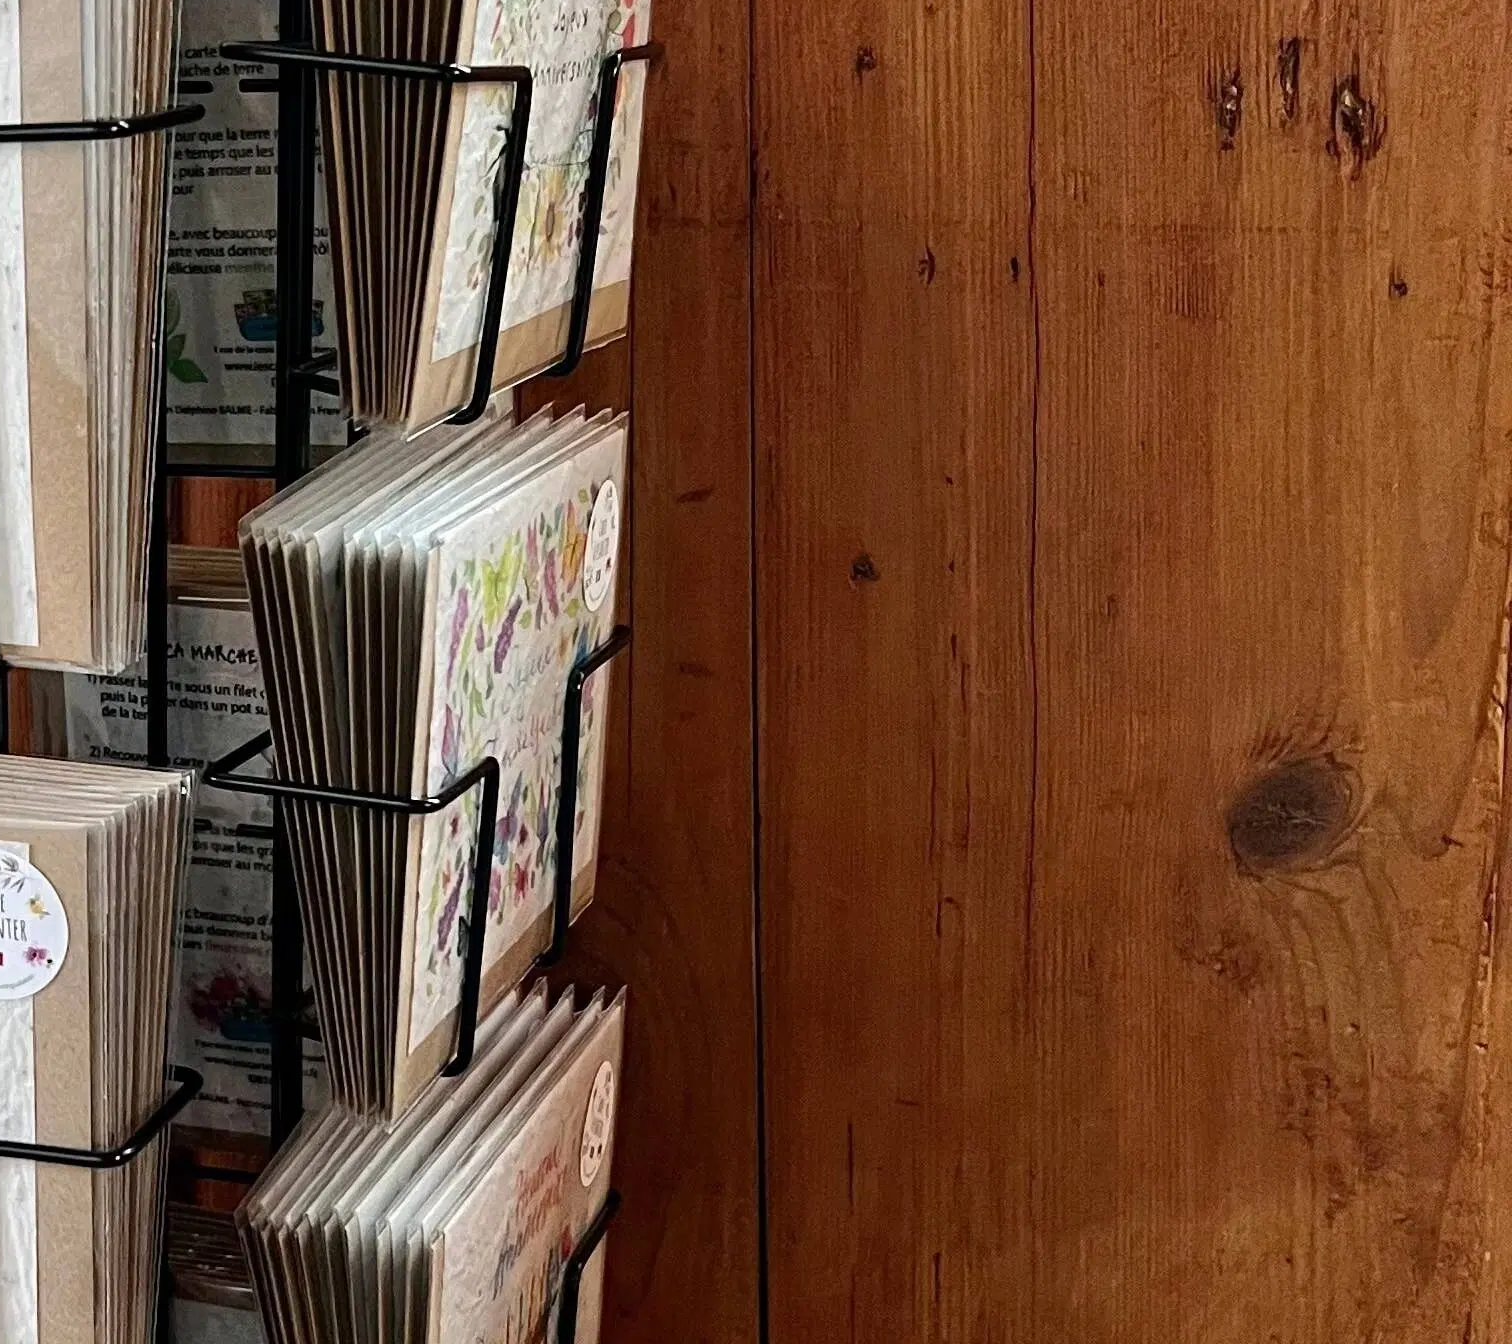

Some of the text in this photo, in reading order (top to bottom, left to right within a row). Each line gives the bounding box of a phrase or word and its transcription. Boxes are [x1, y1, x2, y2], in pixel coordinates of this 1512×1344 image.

[213, 61, 229, 76] de
[199, 131, 223, 144] que
[226, 127, 238, 141] la
[240, 128, 270, 141] terre
[185, 147, 226, 162] temps
[228, 147, 253, 161] que
[256, 144, 274, 158] les
[179, 164, 272, 181] puis arroser au
[182, 229, 210, 240] avec
[195, 246, 225, 258] vous
[190, 644, 258, 665] MARCHE
[185, 683, 212, 694] sous
[214, 684, 231, 696] un
[234, 683, 258, 699] filet
[100, 690, 126, 704] puis
[127, 690, 138, 705] la
[180, 697, 209, 712] dans
[211, 700, 228, 712] un
[231, 702, 252, 715] pot
[101, 705, 117, 718] de
[119, 705, 130, 719] la
